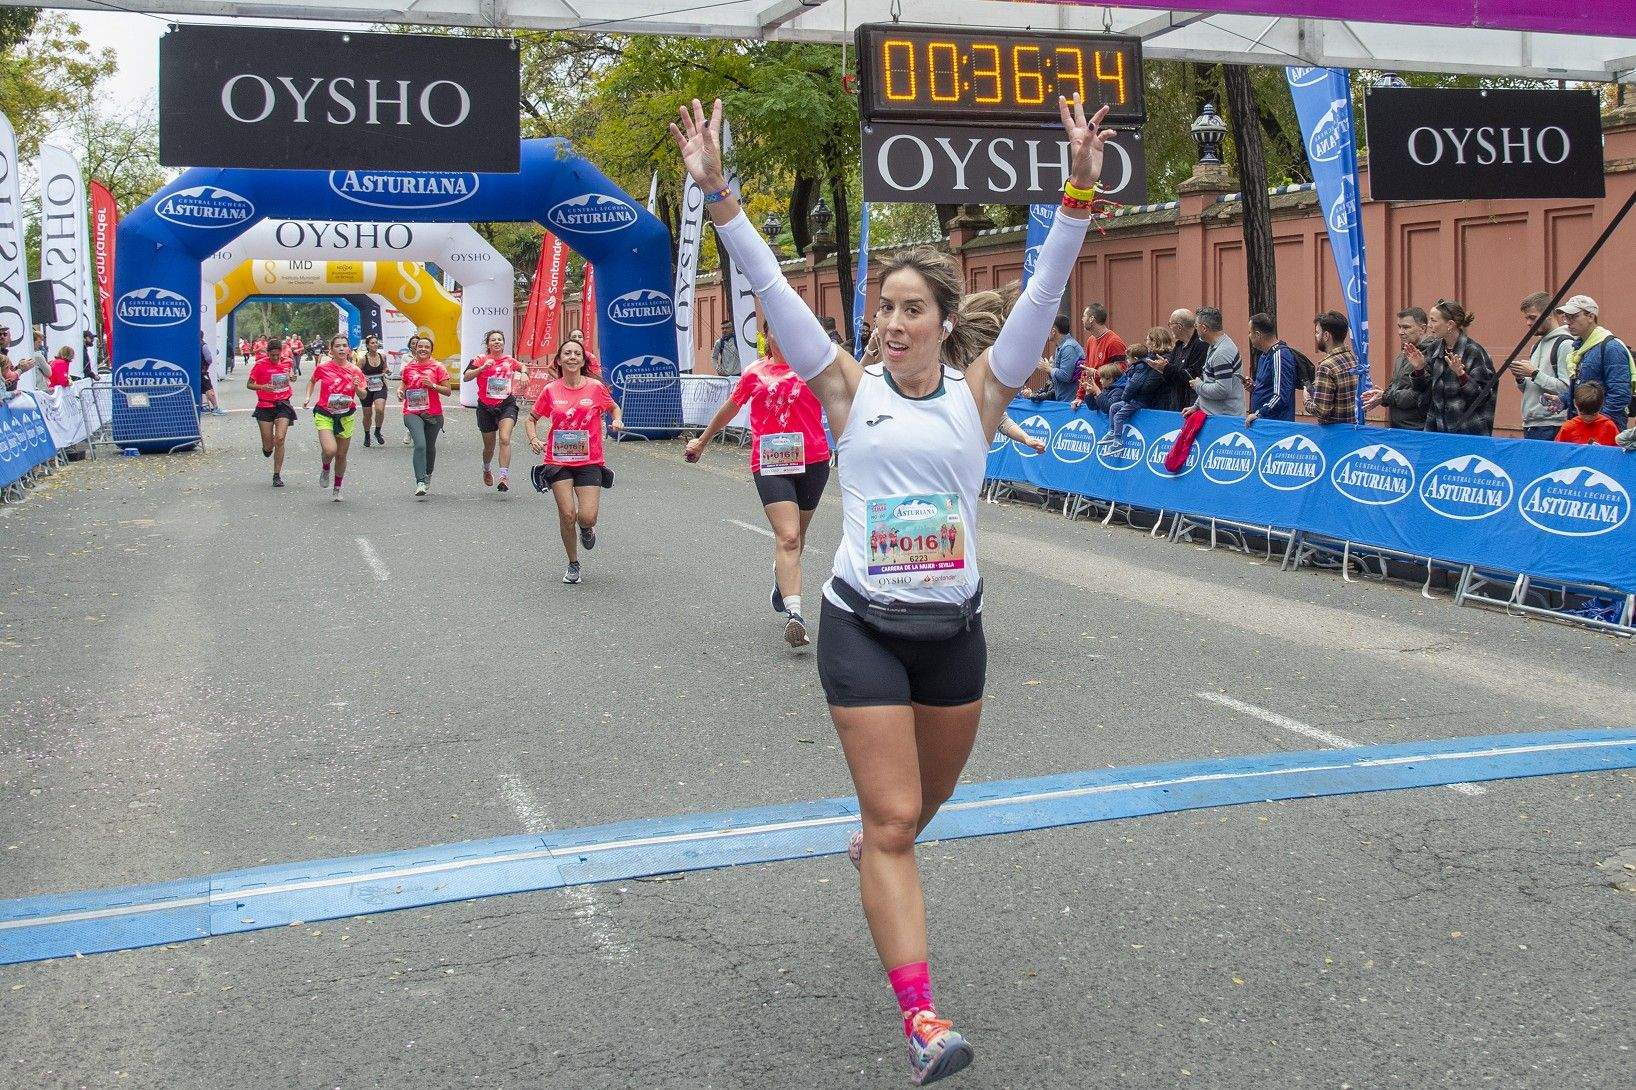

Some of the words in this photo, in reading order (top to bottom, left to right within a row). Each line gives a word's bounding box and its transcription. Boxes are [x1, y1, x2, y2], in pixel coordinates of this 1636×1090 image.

[884, 40, 1125, 105] 00:36:34
[221, 74, 471, 128] OYSHO
[1408, 126, 1571, 165] OYSHO
[340, 170, 468, 194] ASTURIANA
[163, 199, 247, 219] ASTURIANA
[555, 210, 633, 225] ASTURIANA
[275, 222, 414, 250] OYSHO
[289, 261, 313, 270] IMD
[451, 253, 491, 262] OYSHO
[548, 239, 563, 293] Santande
[119, 301, 187, 318] ASTURIANA
[472, 306, 509, 316] OYSHO
[613, 304, 673, 319] ASTURIANA
[541, 311, 555, 347] Sports
[117, 373, 185, 387] ASTURIANA
[1054, 433, 1091, 454] ASTURIANA
[1203, 450, 1251, 472] ASTURIANA
[1262, 453, 1315, 478] ASTURIANA
[1355, 462, 1381, 471] CENTRAL
[1337, 462, 1408, 494] ASTURIANA
[1442, 474, 1472, 484] CENTRAL
[1473, 478, 1505, 488] LECHERA
[1424, 475, 1503, 507] ASTURIANA
[1547, 486, 1582, 497] CENTRAL
[1584, 491, 1621, 503] LECHERA
[896, 508, 935, 518] ASTURIANA
[1525, 487, 1619, 523] ASTURIANA
[900, 535, 939, 552] 016
[909, 555, 928, 563] 6223
[879, 576, 912, 586] OYSHO
[931, 574, 957, 583] Santander
